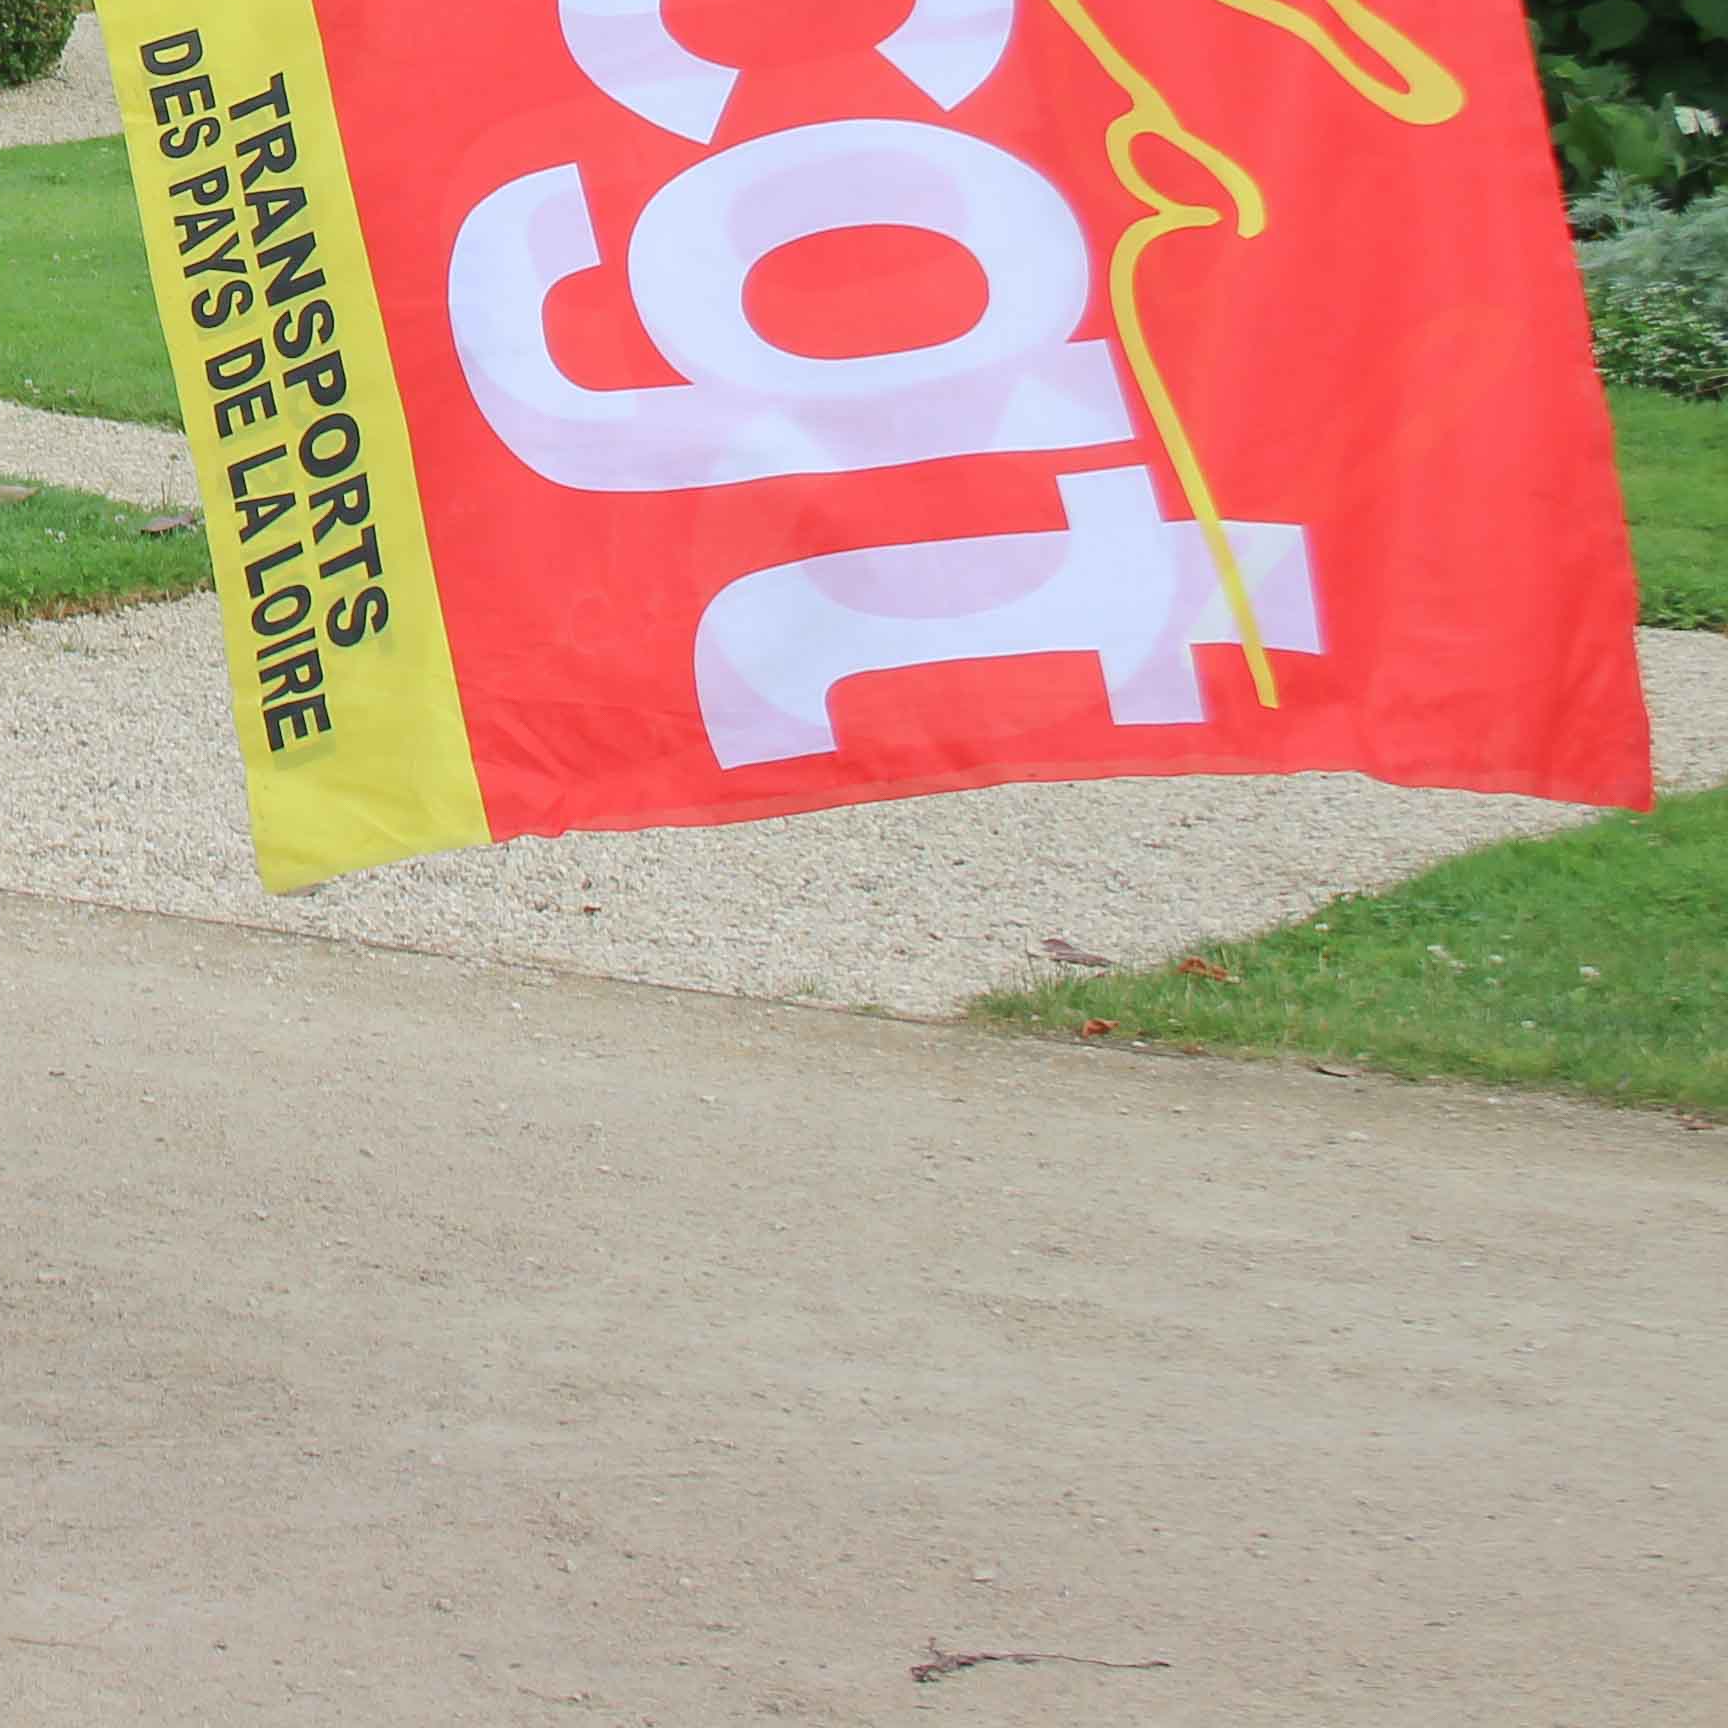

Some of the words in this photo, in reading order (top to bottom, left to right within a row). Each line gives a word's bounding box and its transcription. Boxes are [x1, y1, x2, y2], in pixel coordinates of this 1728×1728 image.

[139, 27, 222, 160] DES
[168, 163, 254, 331] PAYS
[205, 345, 278, 440] DE
[228, 71, 390, 650] TRANSPORTS
[226, 443, 295, 544] LA
[243, 539, 332, 753] LOIRE
